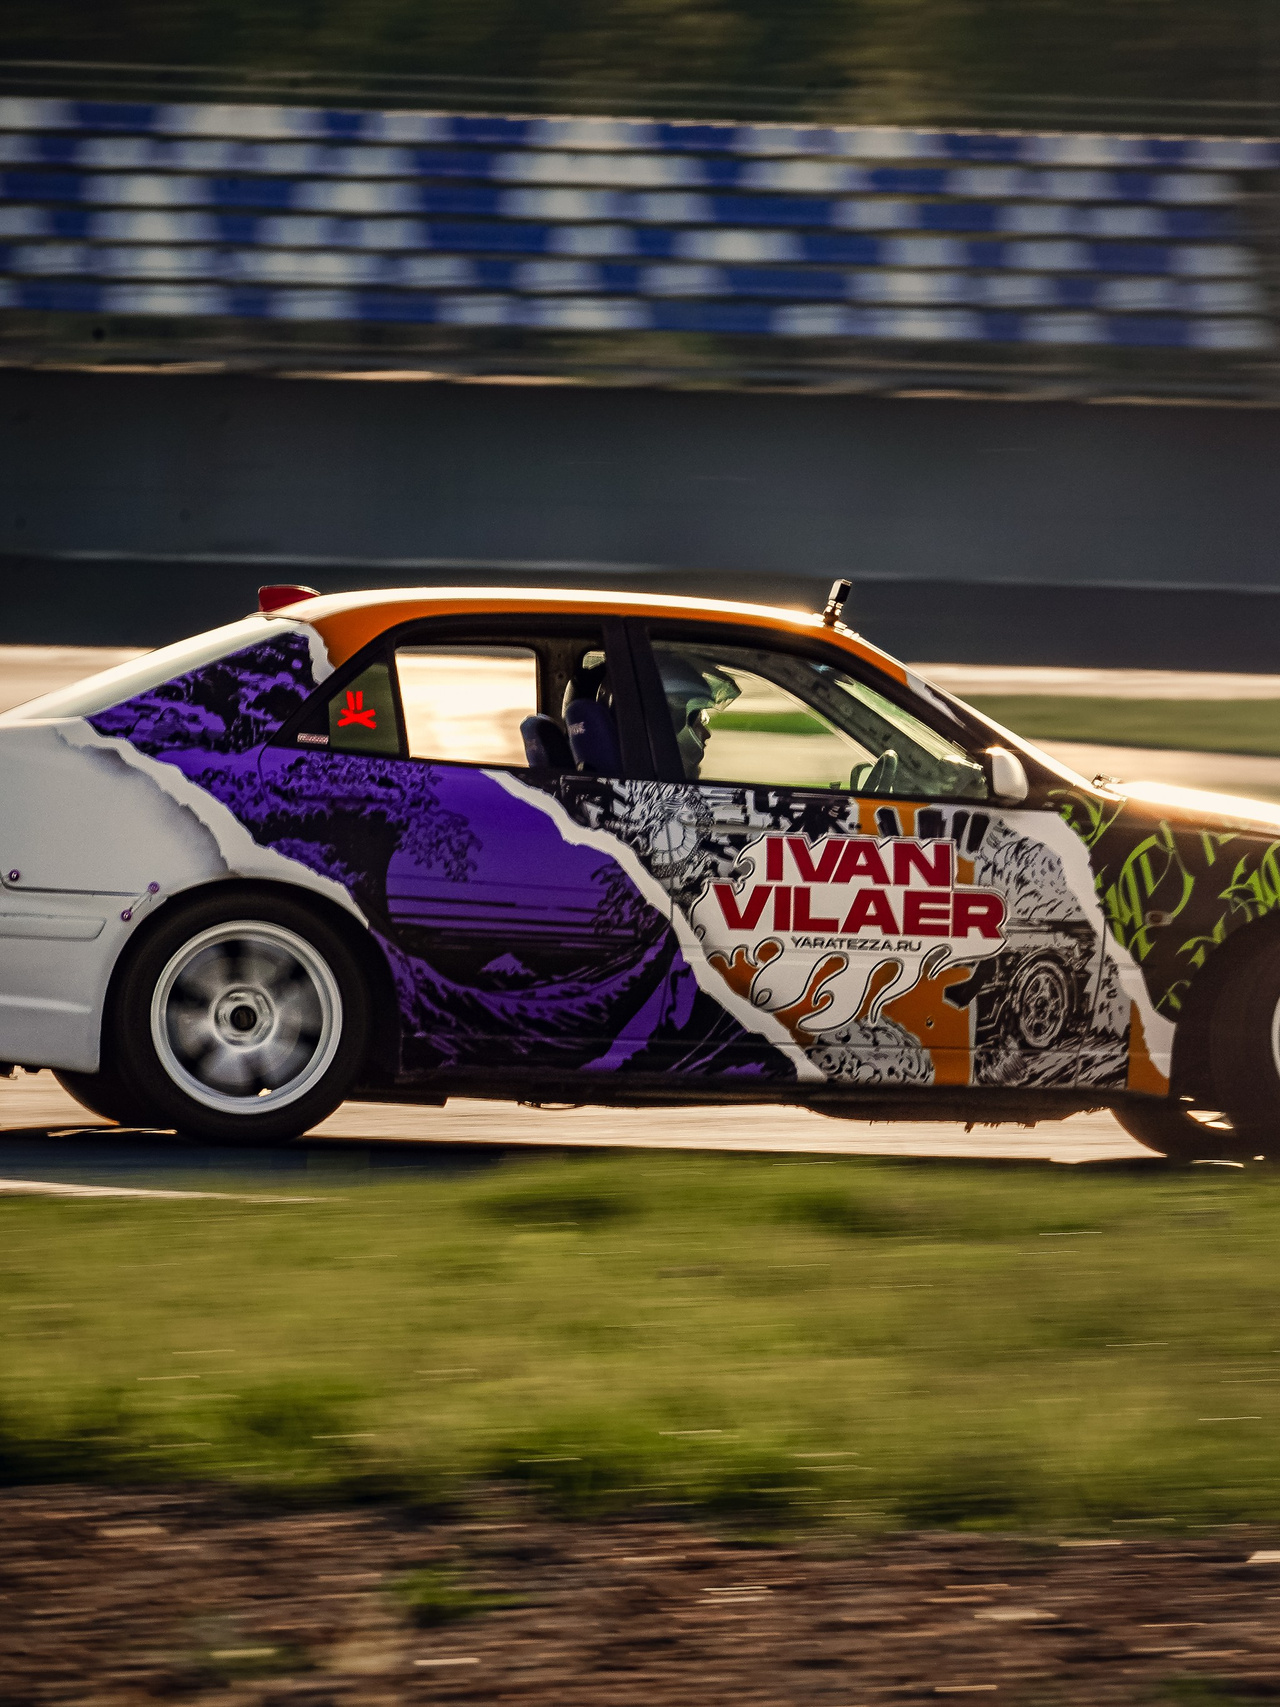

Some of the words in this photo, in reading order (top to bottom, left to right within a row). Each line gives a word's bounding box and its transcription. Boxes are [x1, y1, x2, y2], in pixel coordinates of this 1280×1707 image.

[765, 836, 952, 886] IVAN
[712, 883, 1002, 939] VILAER
[791, 935, 923, 953] YARATEZZA.RU
